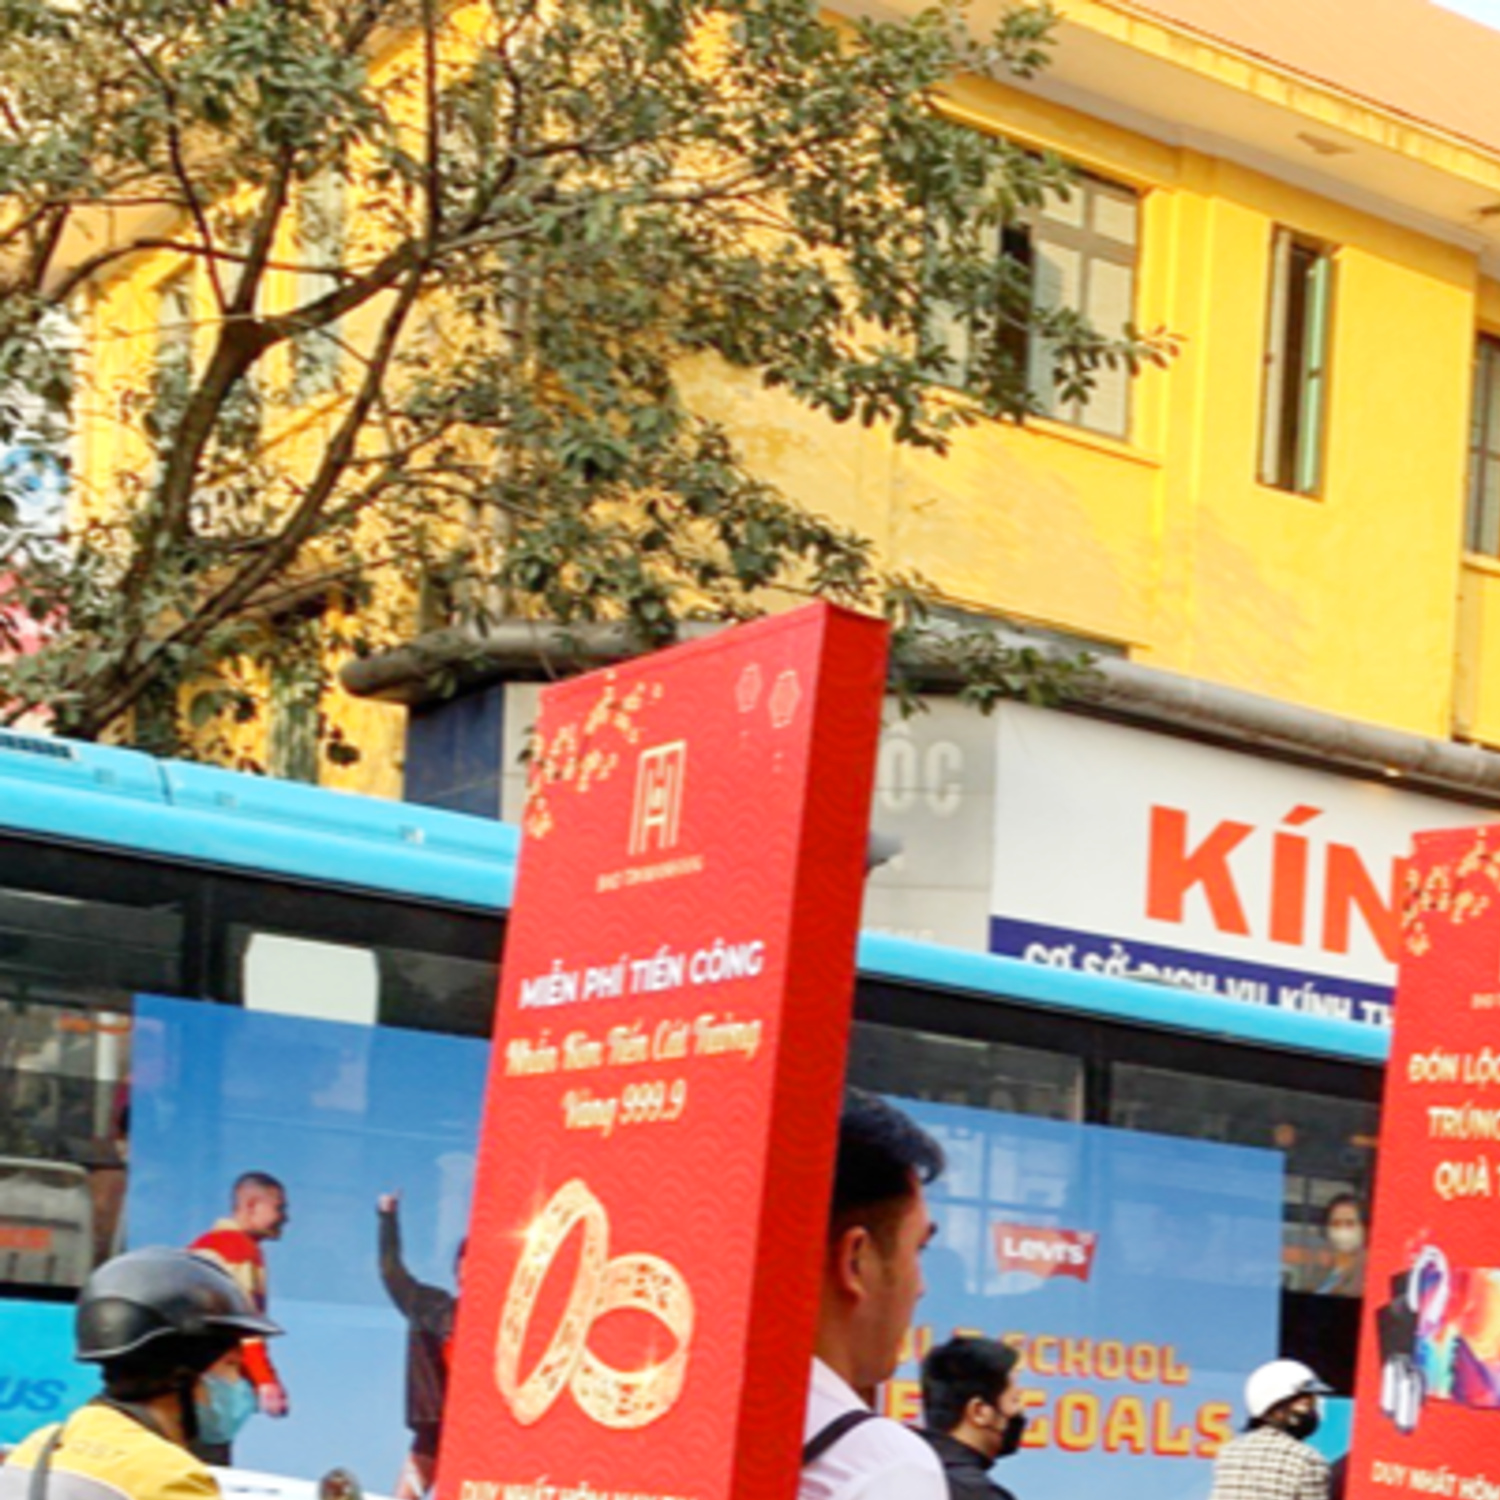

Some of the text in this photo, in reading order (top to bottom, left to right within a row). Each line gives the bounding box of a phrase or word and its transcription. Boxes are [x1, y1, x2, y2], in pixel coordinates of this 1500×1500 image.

[581, 953, 629, 1000] PHÍ
[689, 936, 765, 985] CÔNG
[1407, 1045, 1460, 1082] ĐÓN
[1434, 1154, 1492, 1201] QUÀ
